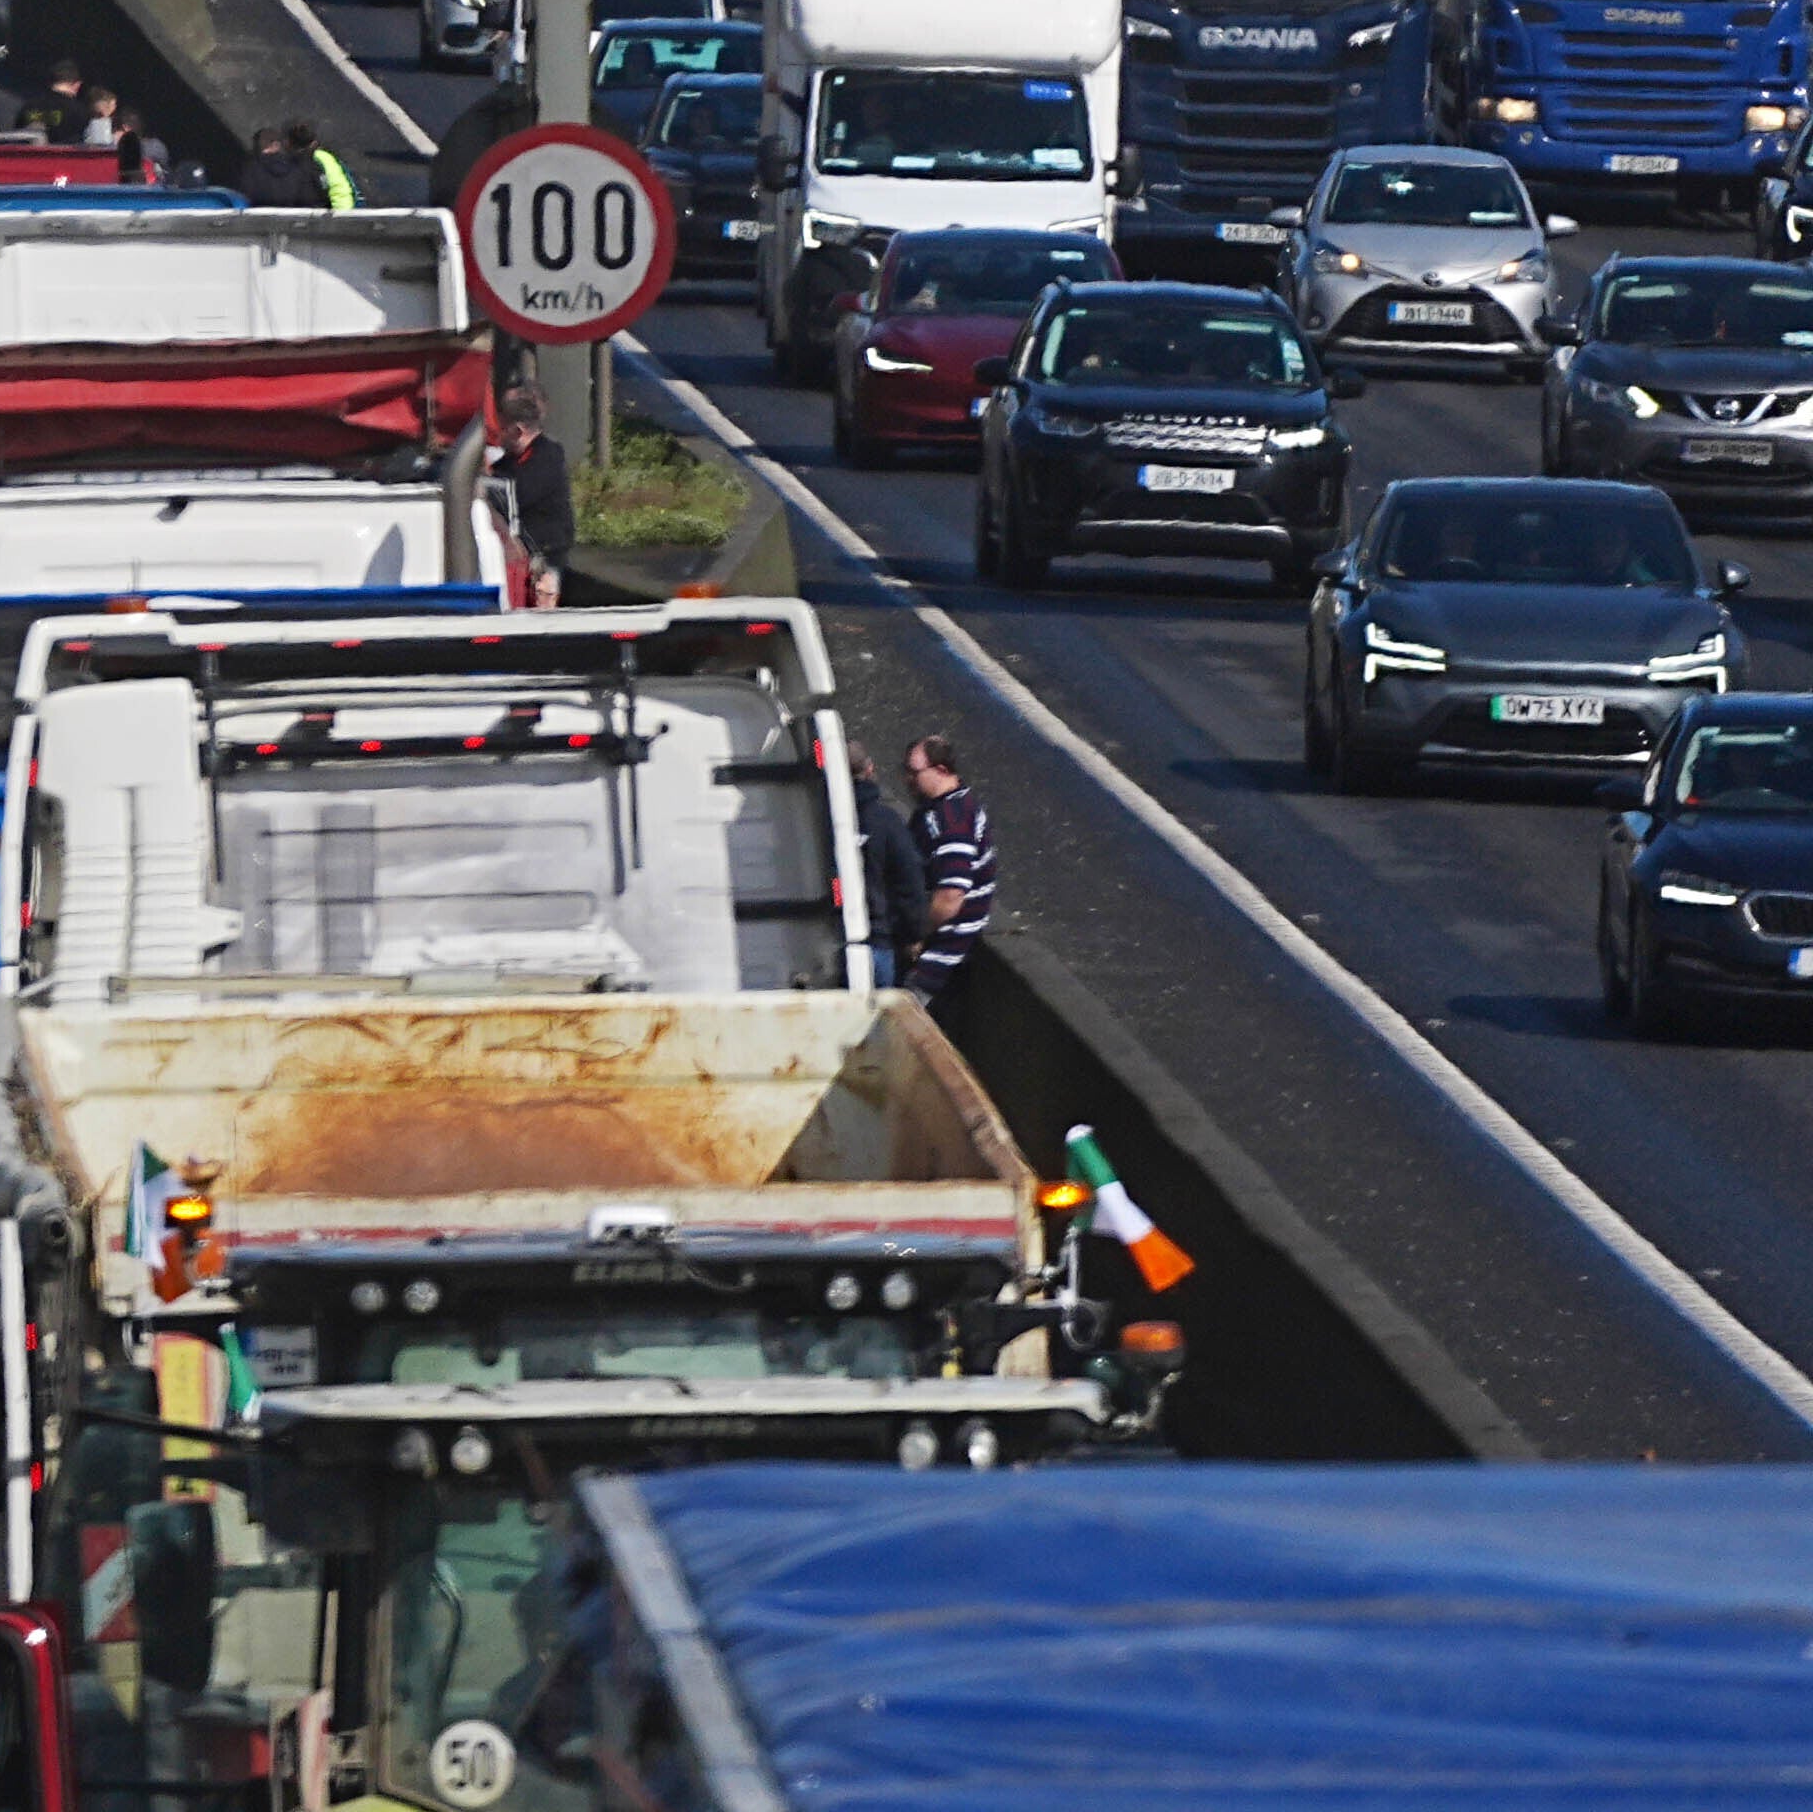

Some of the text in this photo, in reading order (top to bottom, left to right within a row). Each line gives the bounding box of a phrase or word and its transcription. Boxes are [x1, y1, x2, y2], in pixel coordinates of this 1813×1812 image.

[1198, 26, 1318, 52] SCANIA
[490, 180, 636, 271] 100
[521, 283, 604, 313] km/h
[446, 1739, 497, 1789] 50
